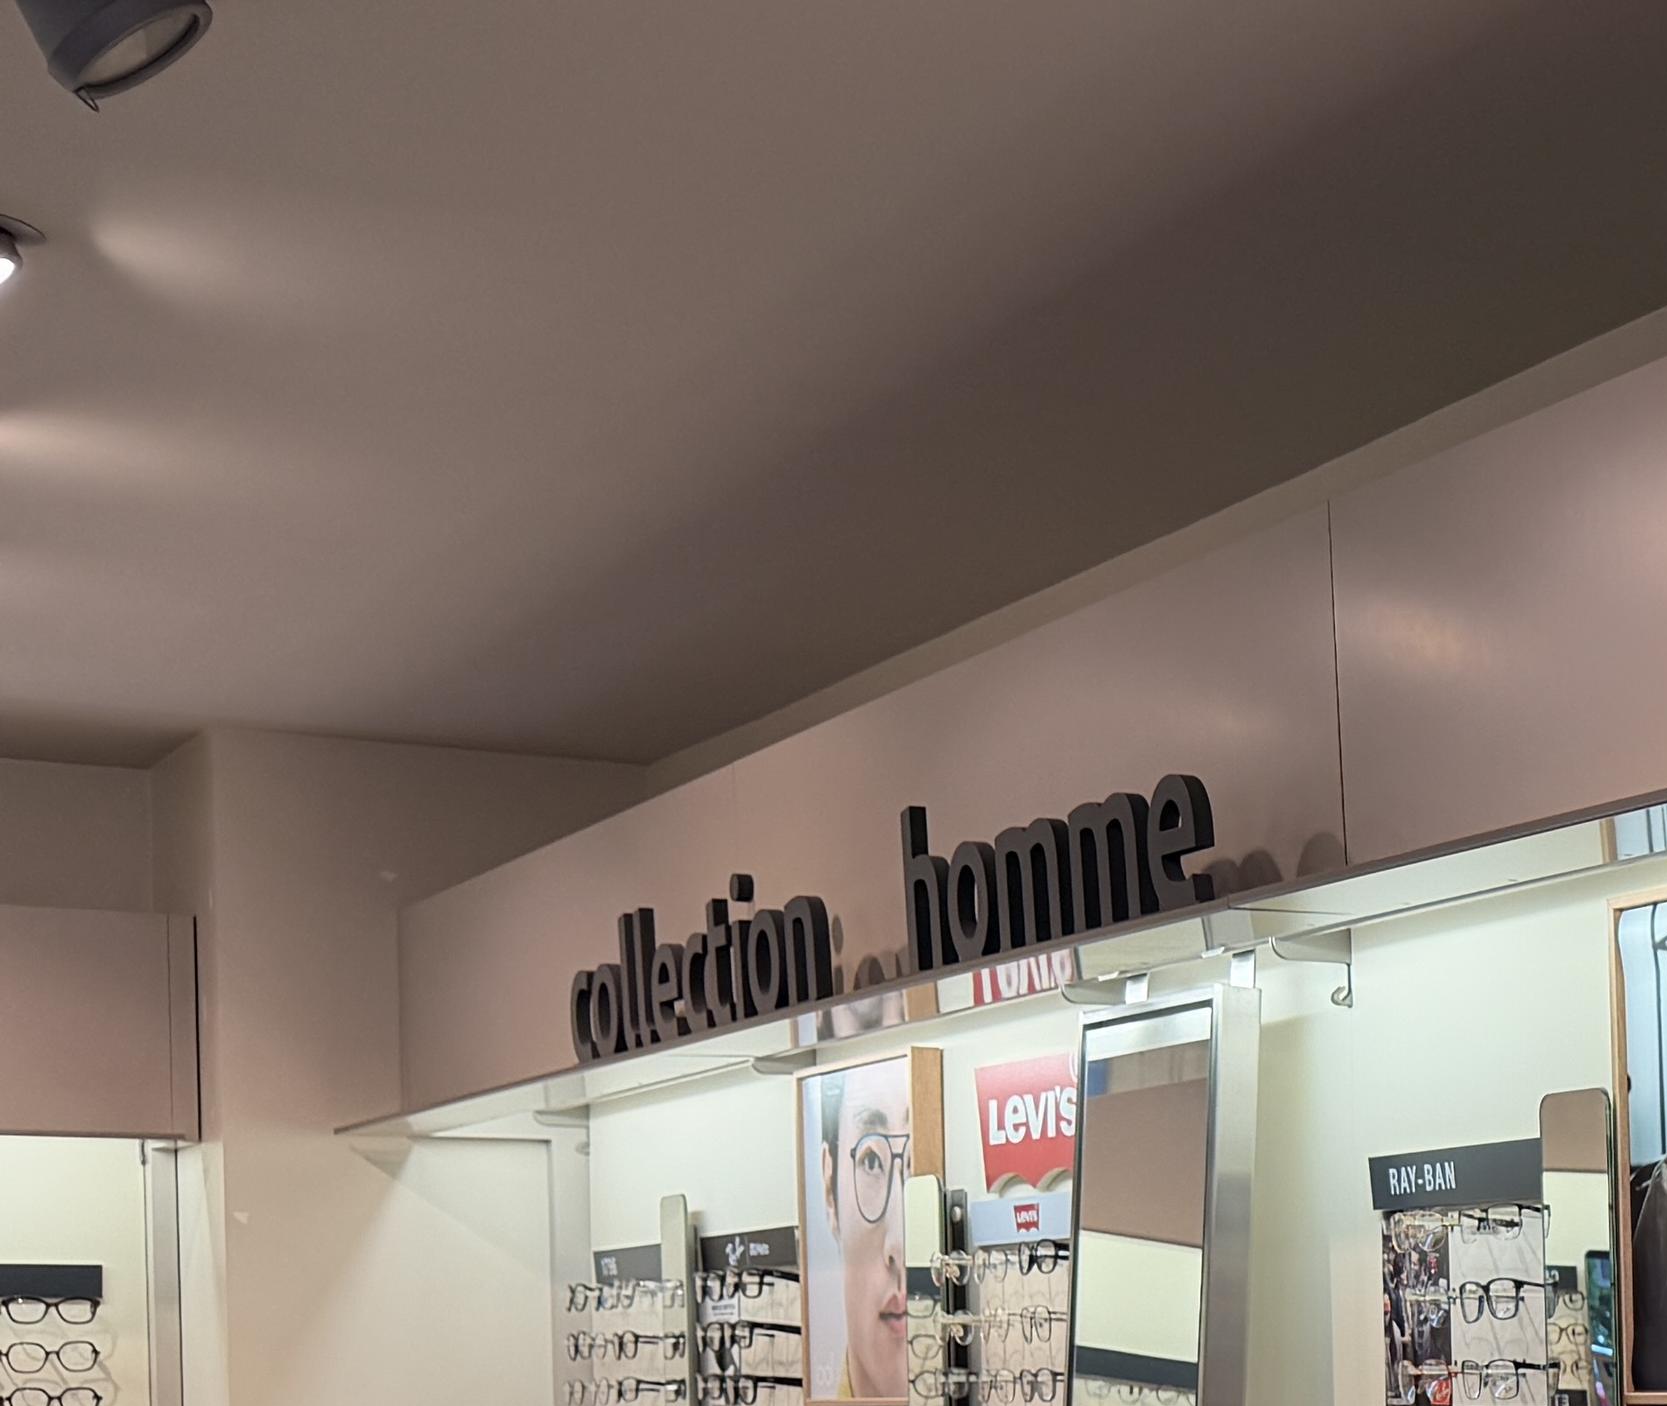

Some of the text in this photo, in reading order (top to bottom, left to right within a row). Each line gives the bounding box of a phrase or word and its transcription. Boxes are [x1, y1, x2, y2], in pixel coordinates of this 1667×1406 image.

[570, 774, 1214, 1062] collection homme
[1388, 1161, 1457, 1195] RAY-BAN
